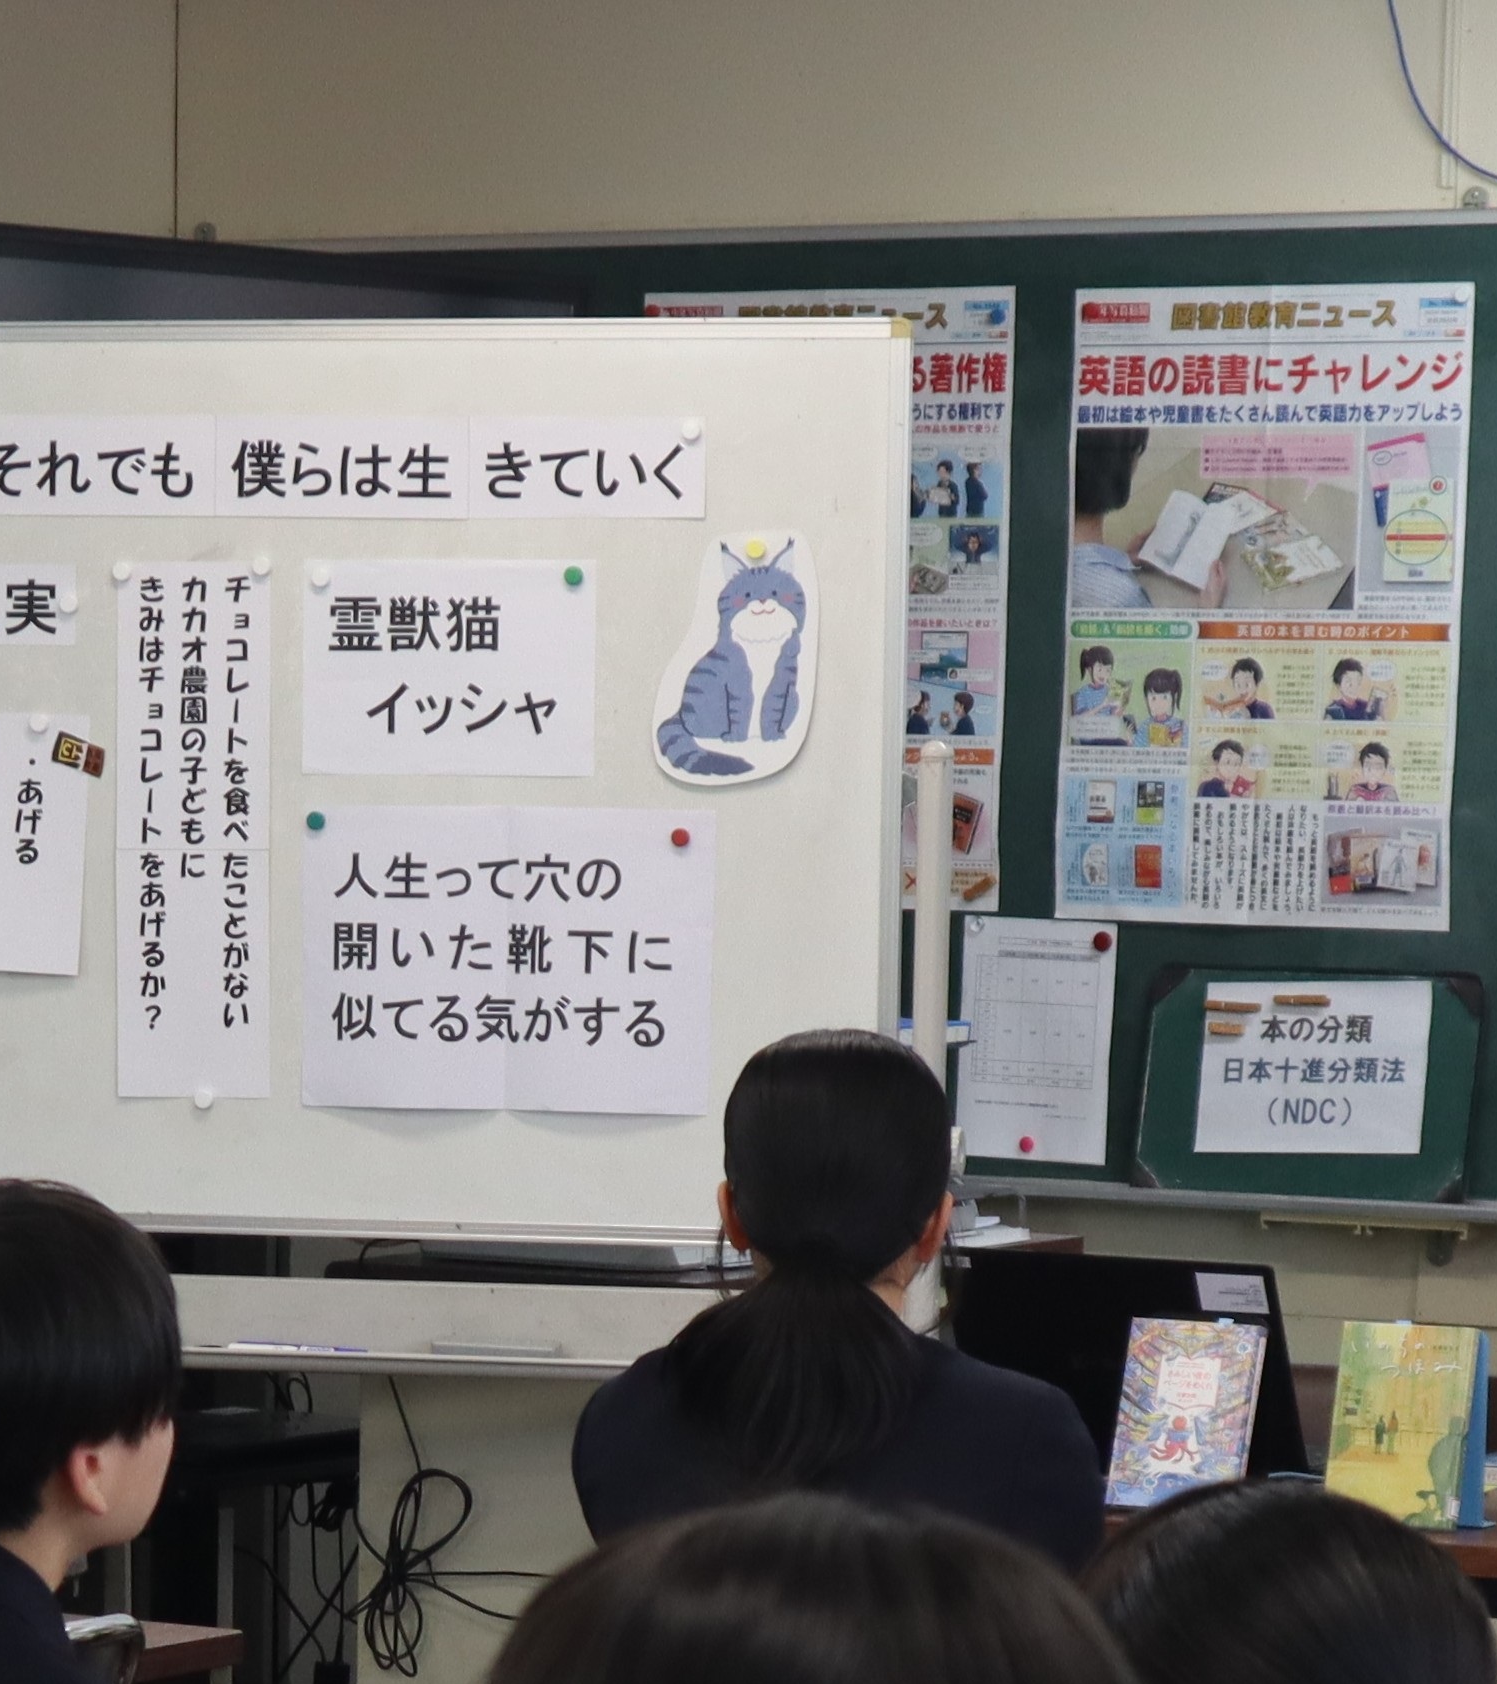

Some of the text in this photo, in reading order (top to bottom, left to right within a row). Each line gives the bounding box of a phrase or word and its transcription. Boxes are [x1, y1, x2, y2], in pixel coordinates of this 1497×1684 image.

[1170, 299, 1397, 331] 図書館教育ニュース
[1079, 350, 1464, 397] 英語の読書にチャレンジ
[1077, 402, 1463, 425] 最初は絵本や児童書をたくさん読んで英語力をアップしよう
[327, 594, 502, 653] 霊獣猫
[1236, 623, 1410, 638] 英語の本を読む時のポイント
[179, 575, 209, 880] カカオ農園の子どもに
[365, 683, 558, 737] イッシャ
[138, 575, 167, 1030] きみはチョコレートをあげるか？
[222, 575, 252, 1028] チョコレートを食べたことがない
[333, 853, 623, 902] 人生って穴の
[333, 922, 674, 975] 開いた靴下に
[332, 993, 667, 1049] 似てる気がする
[1260, 1014, 1373, 1044] 本の分類
[1222, 1058, 1406, 1085] 日本十進分類法
